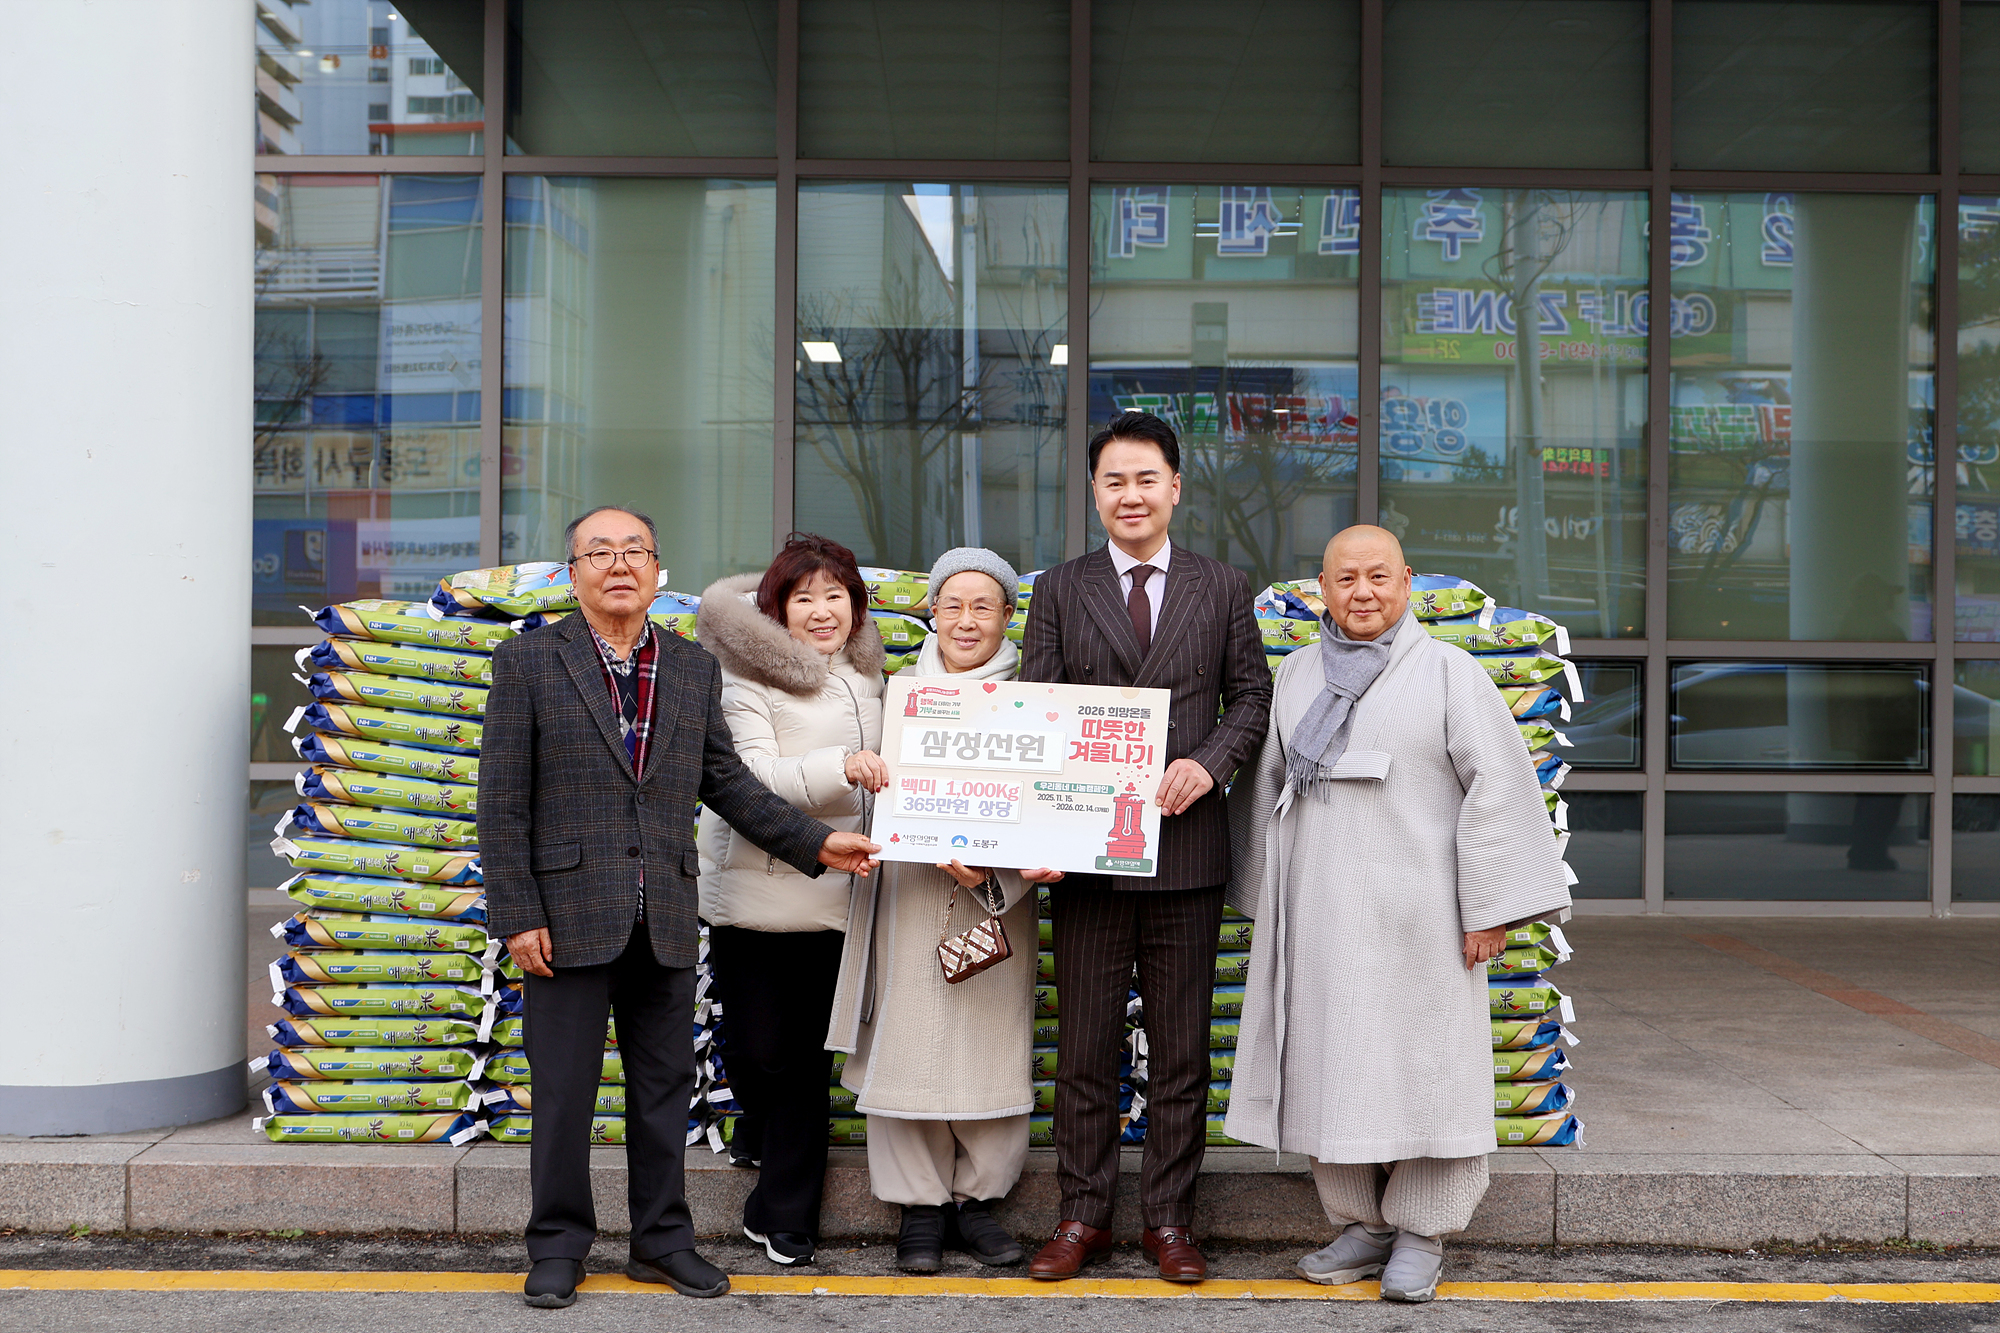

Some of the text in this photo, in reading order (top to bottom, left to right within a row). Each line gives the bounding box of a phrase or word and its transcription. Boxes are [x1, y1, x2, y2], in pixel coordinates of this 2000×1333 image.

[1078, 706, 1152, 719] 2026 희망온돌
[1081, 719, 1146, 742] 따뜻한
[920, 731, 1046, 763] 삼성선원
[1068, 741, 1154, 766] 겨울나기
[901, 778, 1020, 802] 백미 1,000Kg
[1040, 782, 1109, 794] 우리동네 나눔캠페인
[903, 796, 1013, 817] 365만원 상당
[972, 839, 999, 849] 도봉구
